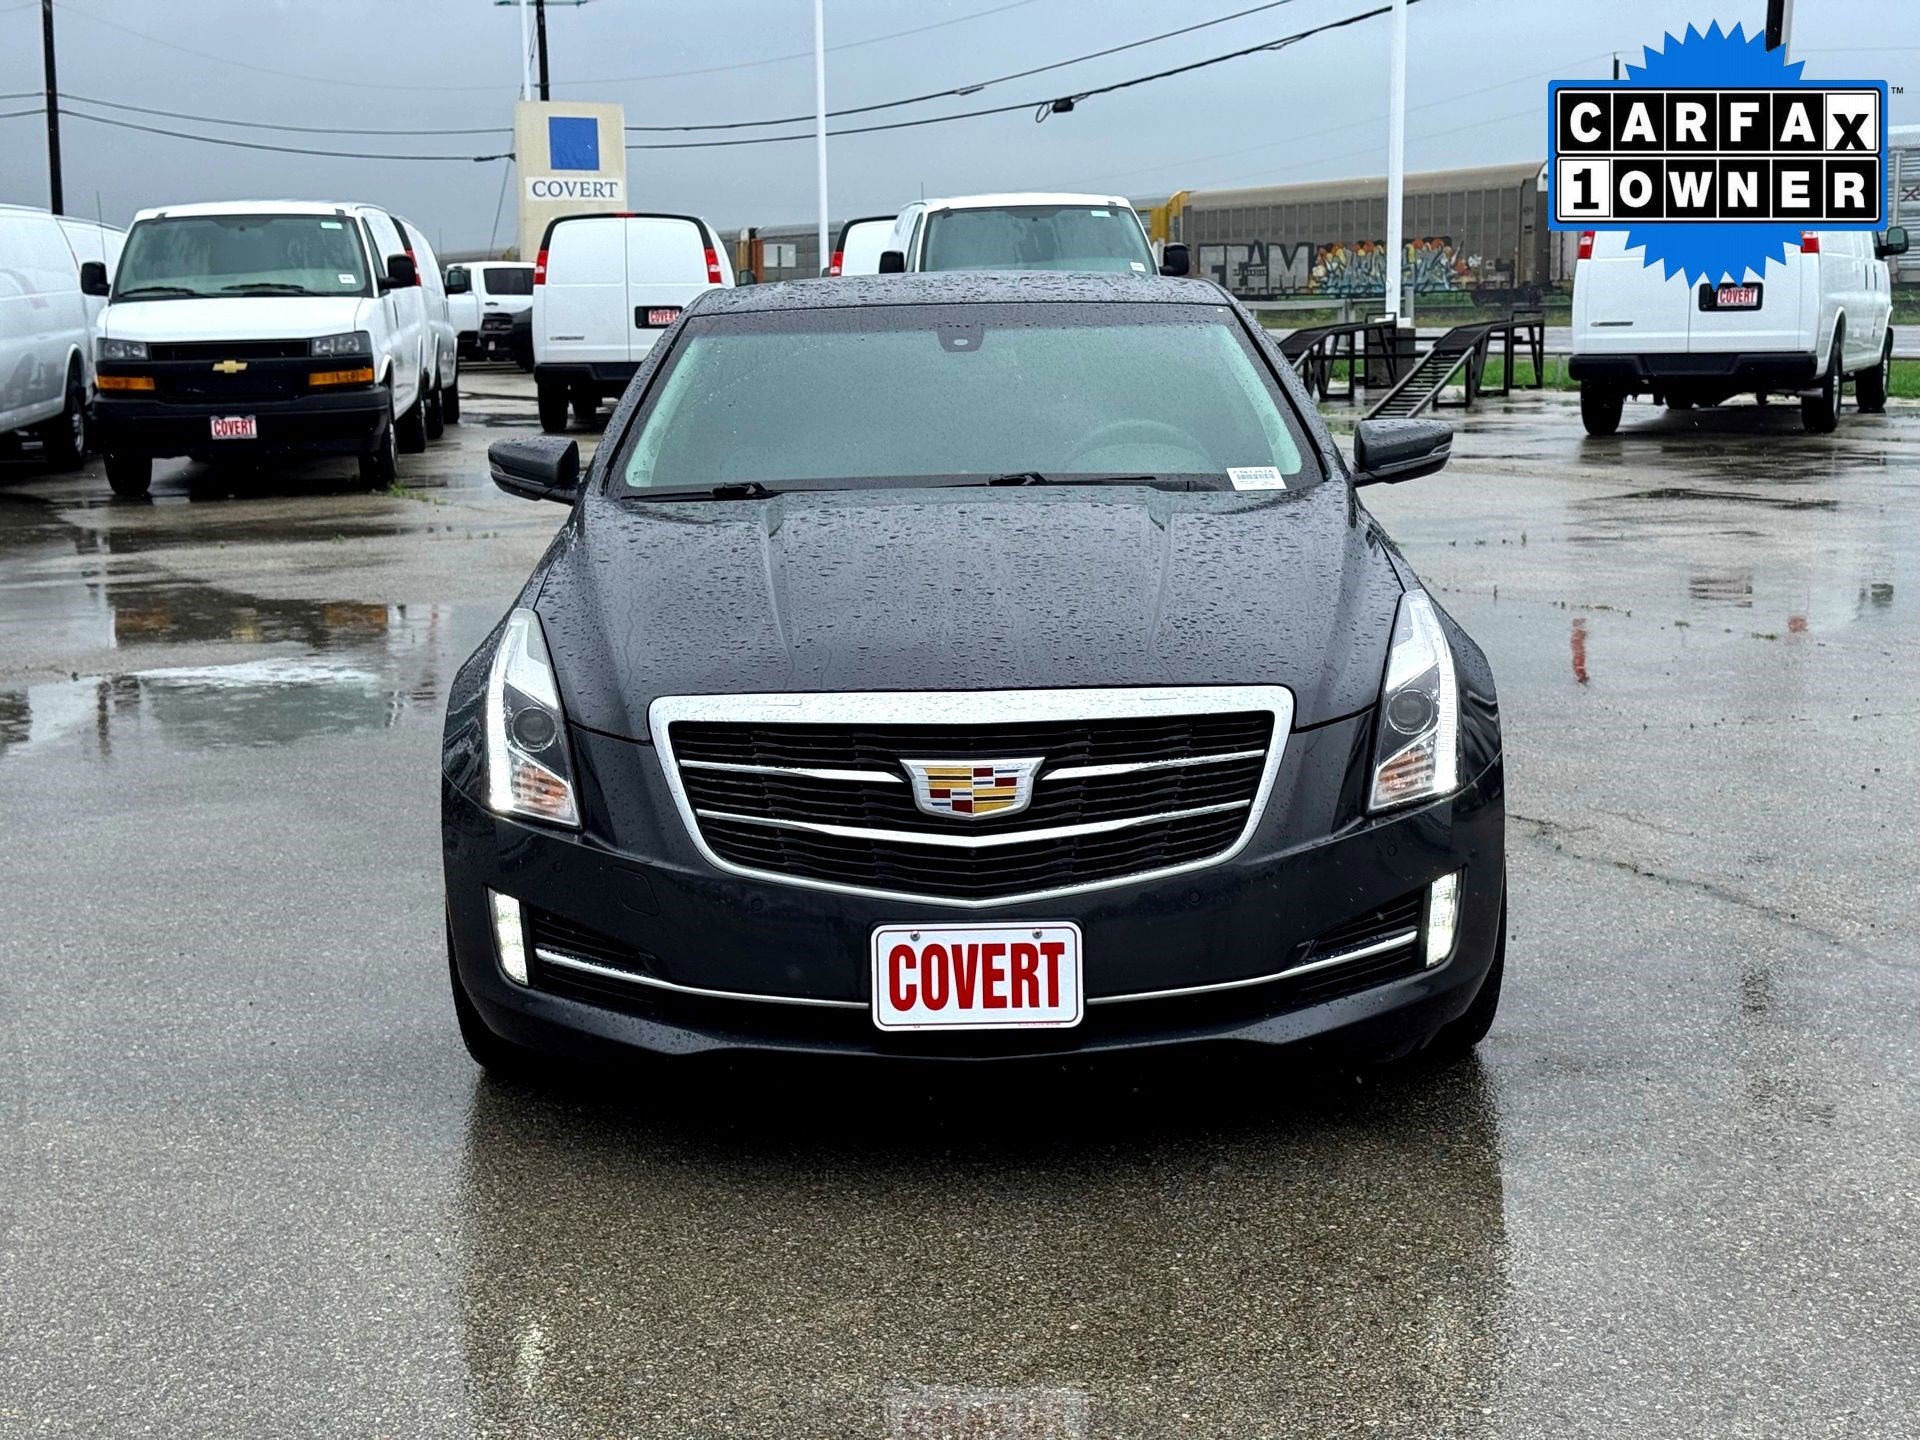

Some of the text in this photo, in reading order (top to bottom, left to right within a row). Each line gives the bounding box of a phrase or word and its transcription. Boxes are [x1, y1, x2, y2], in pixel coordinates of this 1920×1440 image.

[532, 180, 618, 198] COVERT
[1720, 287, 1755, 304] COVERT
[214, 420, 253, 436] COVERT
[888, 942, 1065, 1012] COVERT
